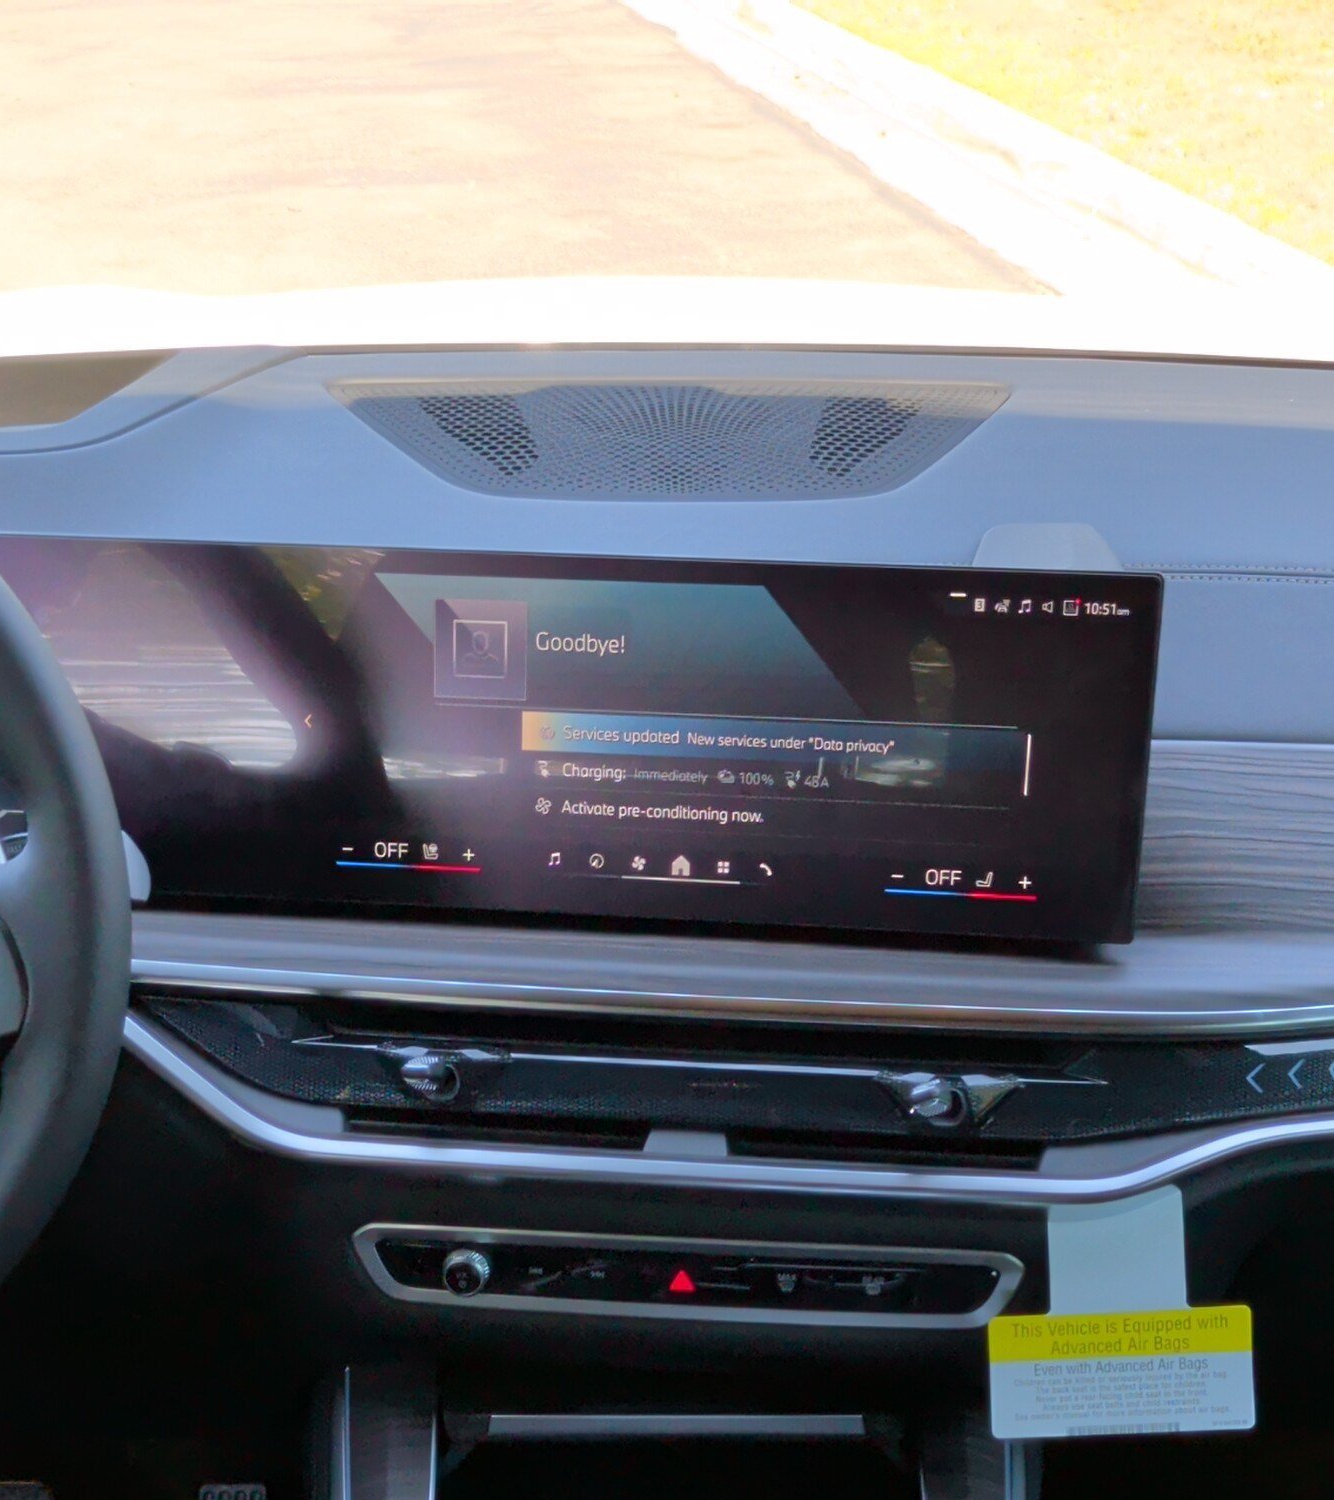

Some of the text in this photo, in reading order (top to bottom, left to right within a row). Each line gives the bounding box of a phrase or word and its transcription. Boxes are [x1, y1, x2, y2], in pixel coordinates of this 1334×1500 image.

[536, 631, 625, 657] Goodbye!
[563, 725, 620, 742] Services
[623, 729, 680, 745] updated
[687, 732, 714, 746] New
[718, 733, 767, 748] services
[770, 735, 806, 750] under
[562, 762, 626, 783] Charging:
[634, 767, 708, 784] Immediately
[739, 771, 775, 786] 100%
[561, 800, 764, 824] Activate pre-conditioning now.
[374, 841, 409, 859] OFF
[925, 868, 962, 886] OFF
[1011, 1314, 1227, 1338] This Vehicle is Equipped with
[1050, 1335, 1189, 1354] Advanced Air Bags
[1033, 1356, 1208, 1376] Even with Advanced Air Bags
